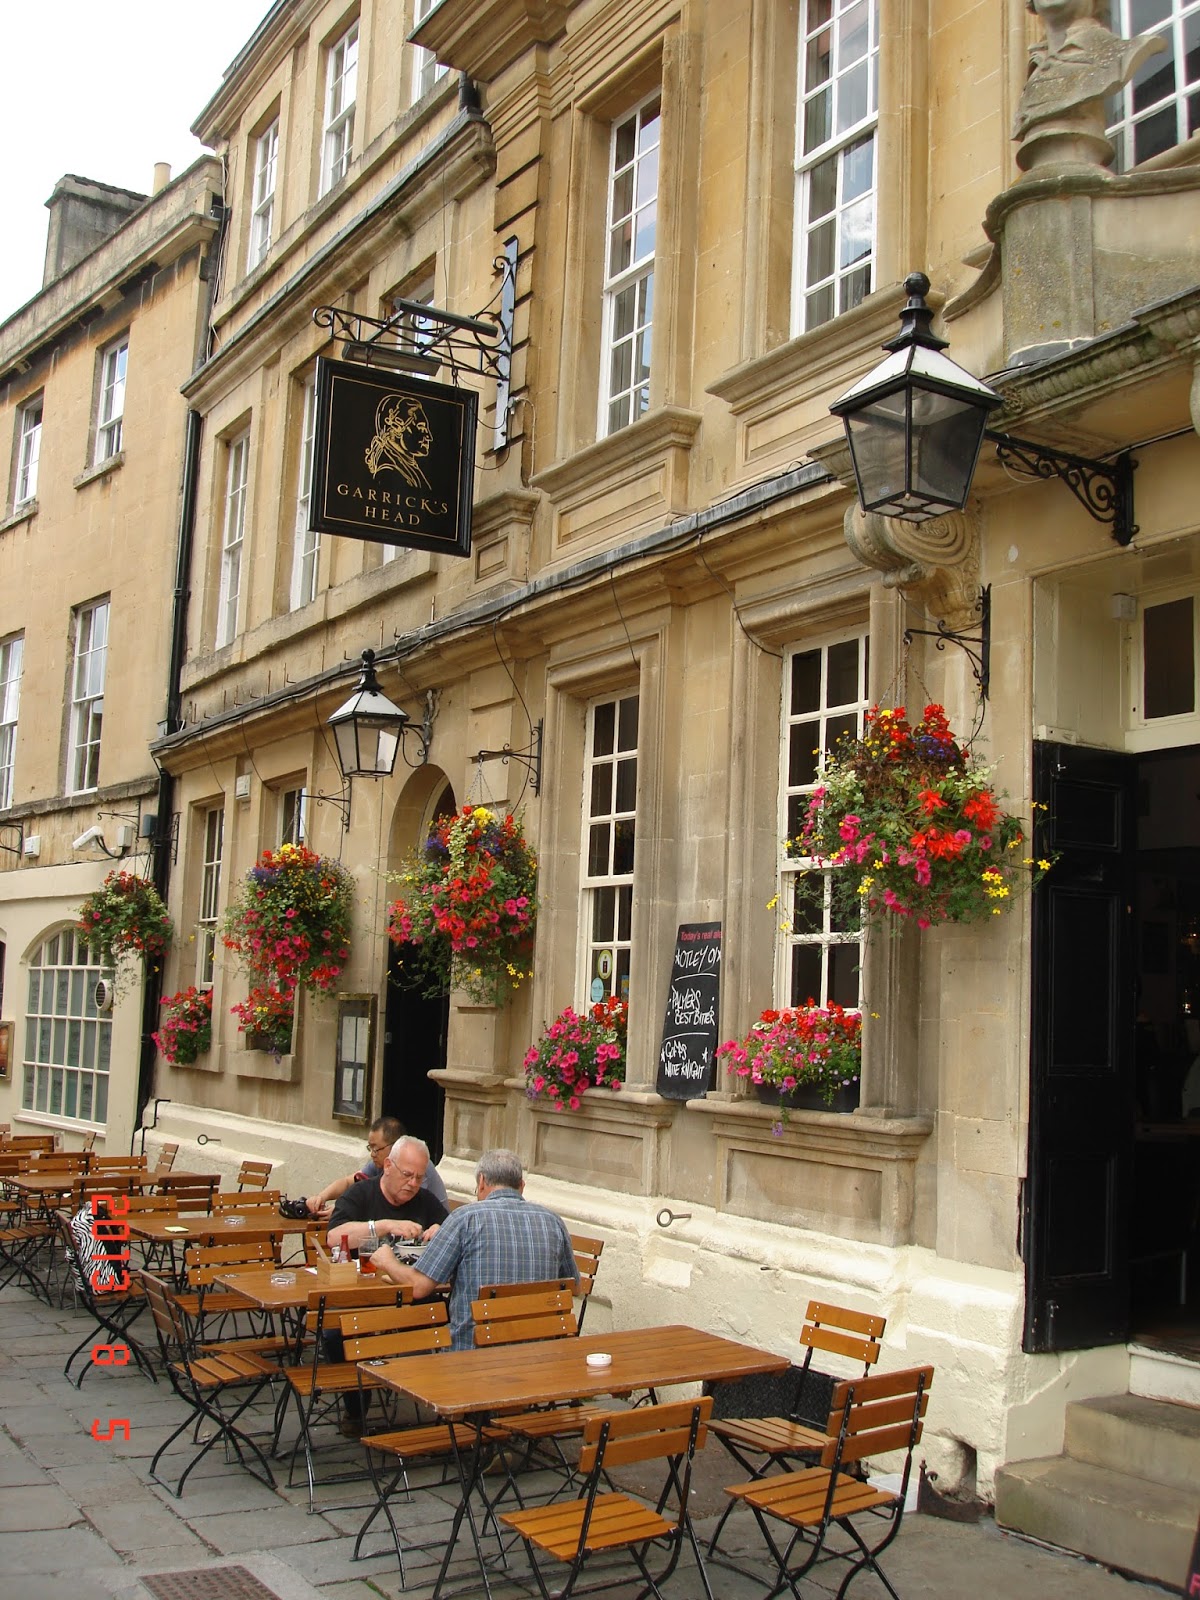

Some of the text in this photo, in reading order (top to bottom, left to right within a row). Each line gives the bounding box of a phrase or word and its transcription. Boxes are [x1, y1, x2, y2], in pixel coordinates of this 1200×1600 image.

[337, 483, 449, 516] GARRICK'S
[365, 506, 421, 526] HEAD
[674, 1009, 695, 1026] BEST
